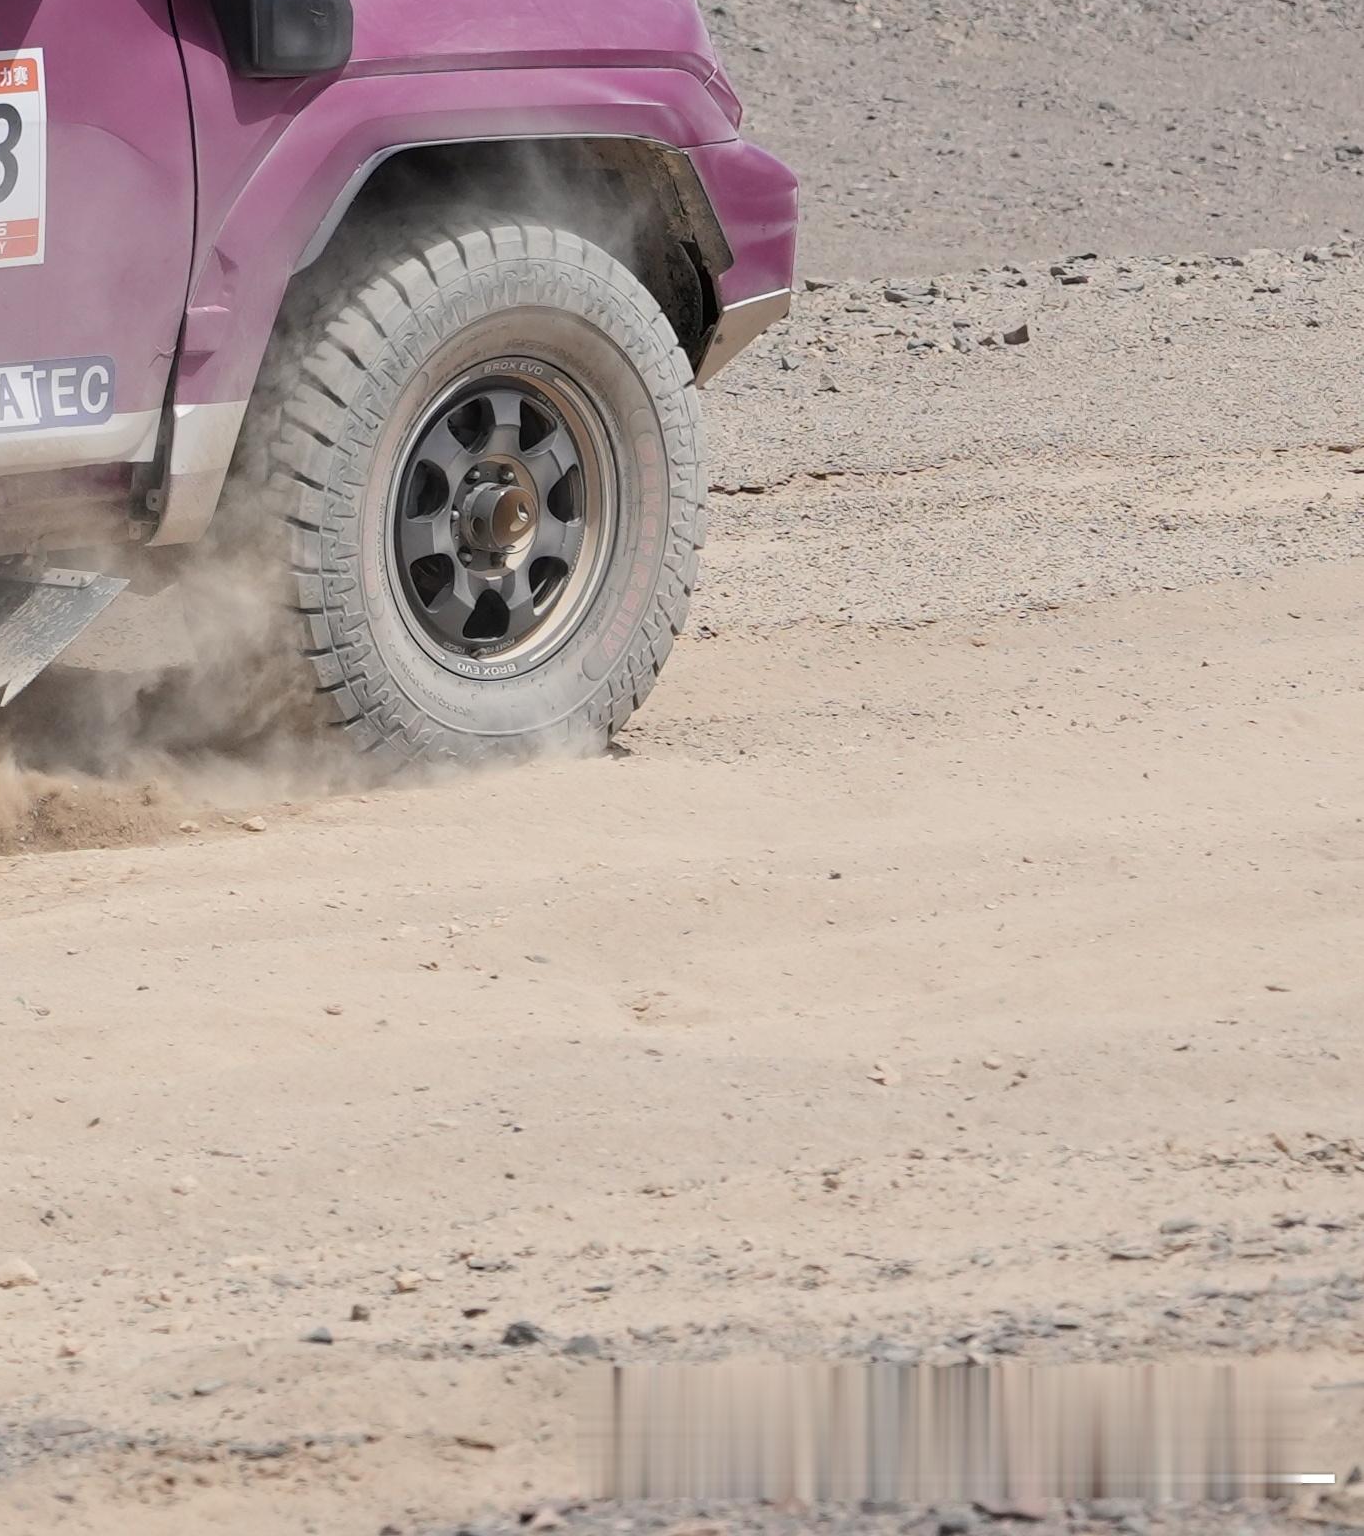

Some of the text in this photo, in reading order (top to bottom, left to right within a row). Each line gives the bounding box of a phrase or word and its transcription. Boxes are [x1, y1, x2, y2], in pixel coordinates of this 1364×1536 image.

[518, 362, 544, 376] EVO
[457, 662, 517, 676] BROX EVO
